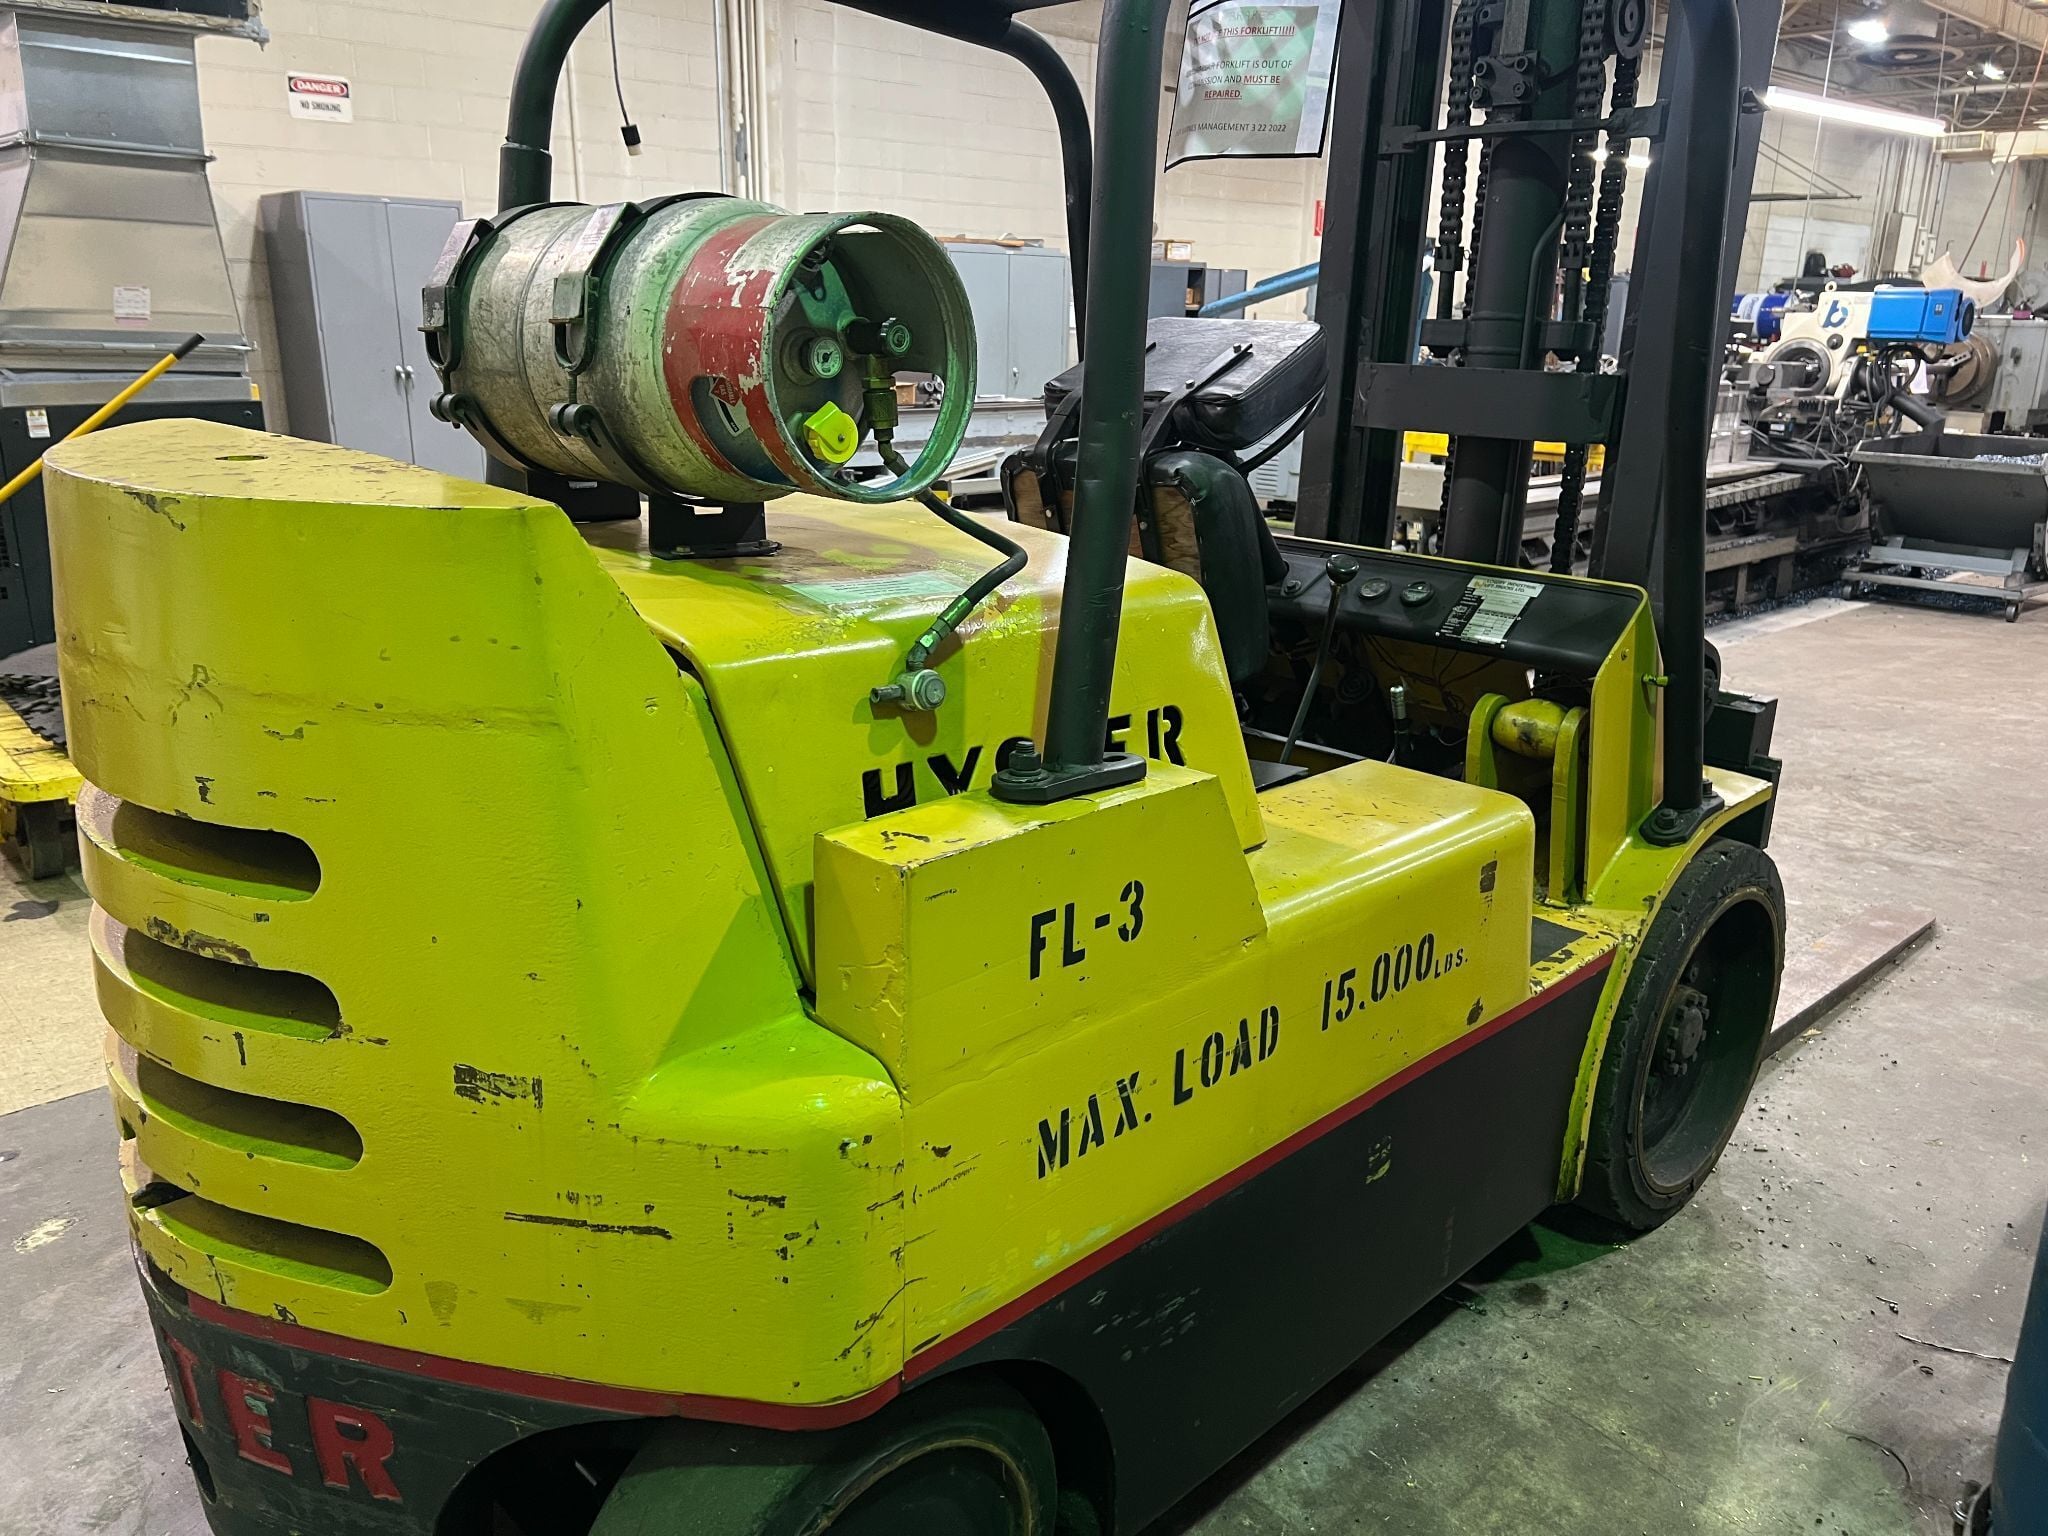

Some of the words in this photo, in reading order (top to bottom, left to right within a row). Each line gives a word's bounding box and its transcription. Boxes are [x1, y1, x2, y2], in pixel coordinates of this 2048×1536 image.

[1223, 28, 1239, 36] THIS
[1216, 60, 1251, 69] FORKLIFT
[1252, 60, 1260, 68] IS
[1261, 60, 1280, 69] OUT
[1281, 60, 1293, 69] OF
[1224, 75, 1242, 84] AND
[1243, 75, 1268, 84] MUST
[1269, 75, 1281, 84] BE
[296, 80, 341, 94] DANGER
[1203, 90, 1243, 99] REPAIRED.
[300, 100, 310, 109] NO
[311, 101, 342, 112] SMOKING
[1197, 123, 1250, 132] MANAGEMENT
[1251, 124, 1256, 132] 3
[1257, 124, 1268, 132] 22
[1268, 124, 1287, 132] 2022
[862, 704, 1187, 821] HYER
[1030, 879, 1145, 981] FL-3
[1037, 1071, 1152, 1180] MAX.
[1173, 1005, 1280, 1106] LOAD
[1321, 932, 1435, 1032] 15.000
